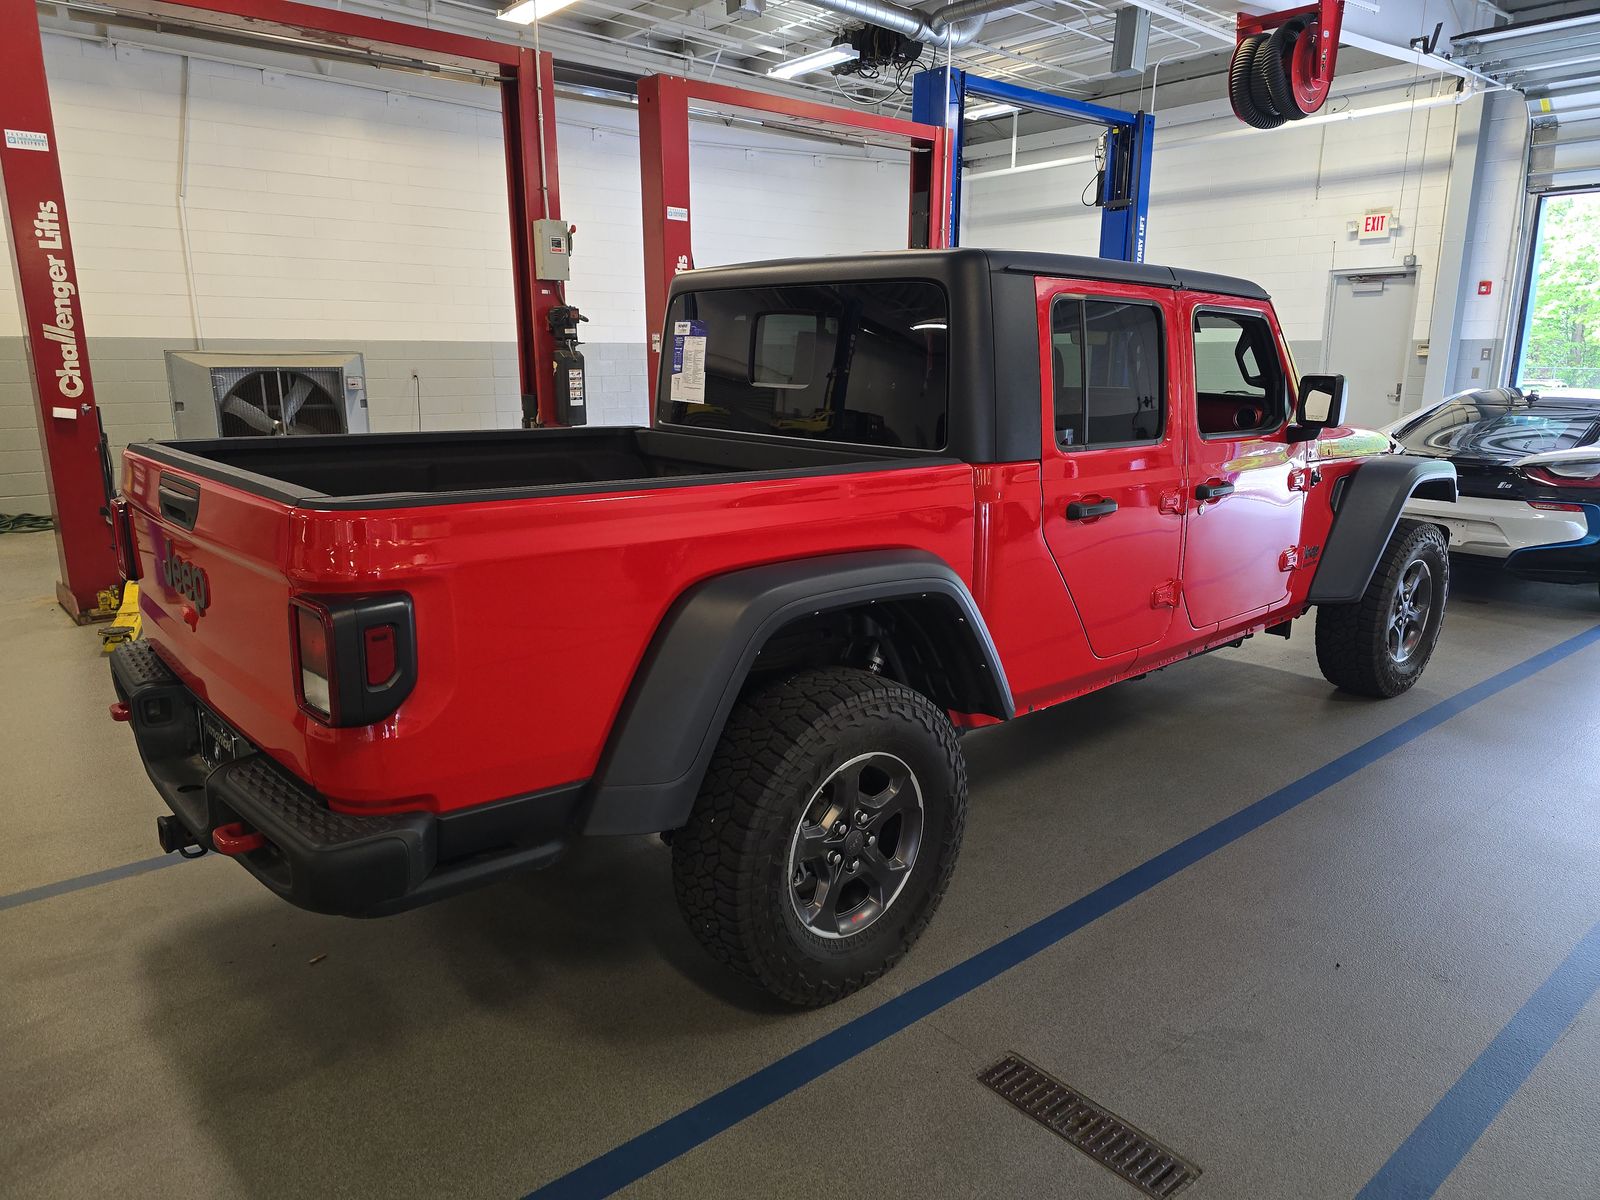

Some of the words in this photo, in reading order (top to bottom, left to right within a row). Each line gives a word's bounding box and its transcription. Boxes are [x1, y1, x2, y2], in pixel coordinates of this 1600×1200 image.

[34, 200, 63, 250] Lifts
[1138, 216, 1146, 236] LIFT
[1364, 215, 1386, 232] EXIT
[42, 254, 84, 398] Challenger
[163, 538, 211, 617] Jeep
